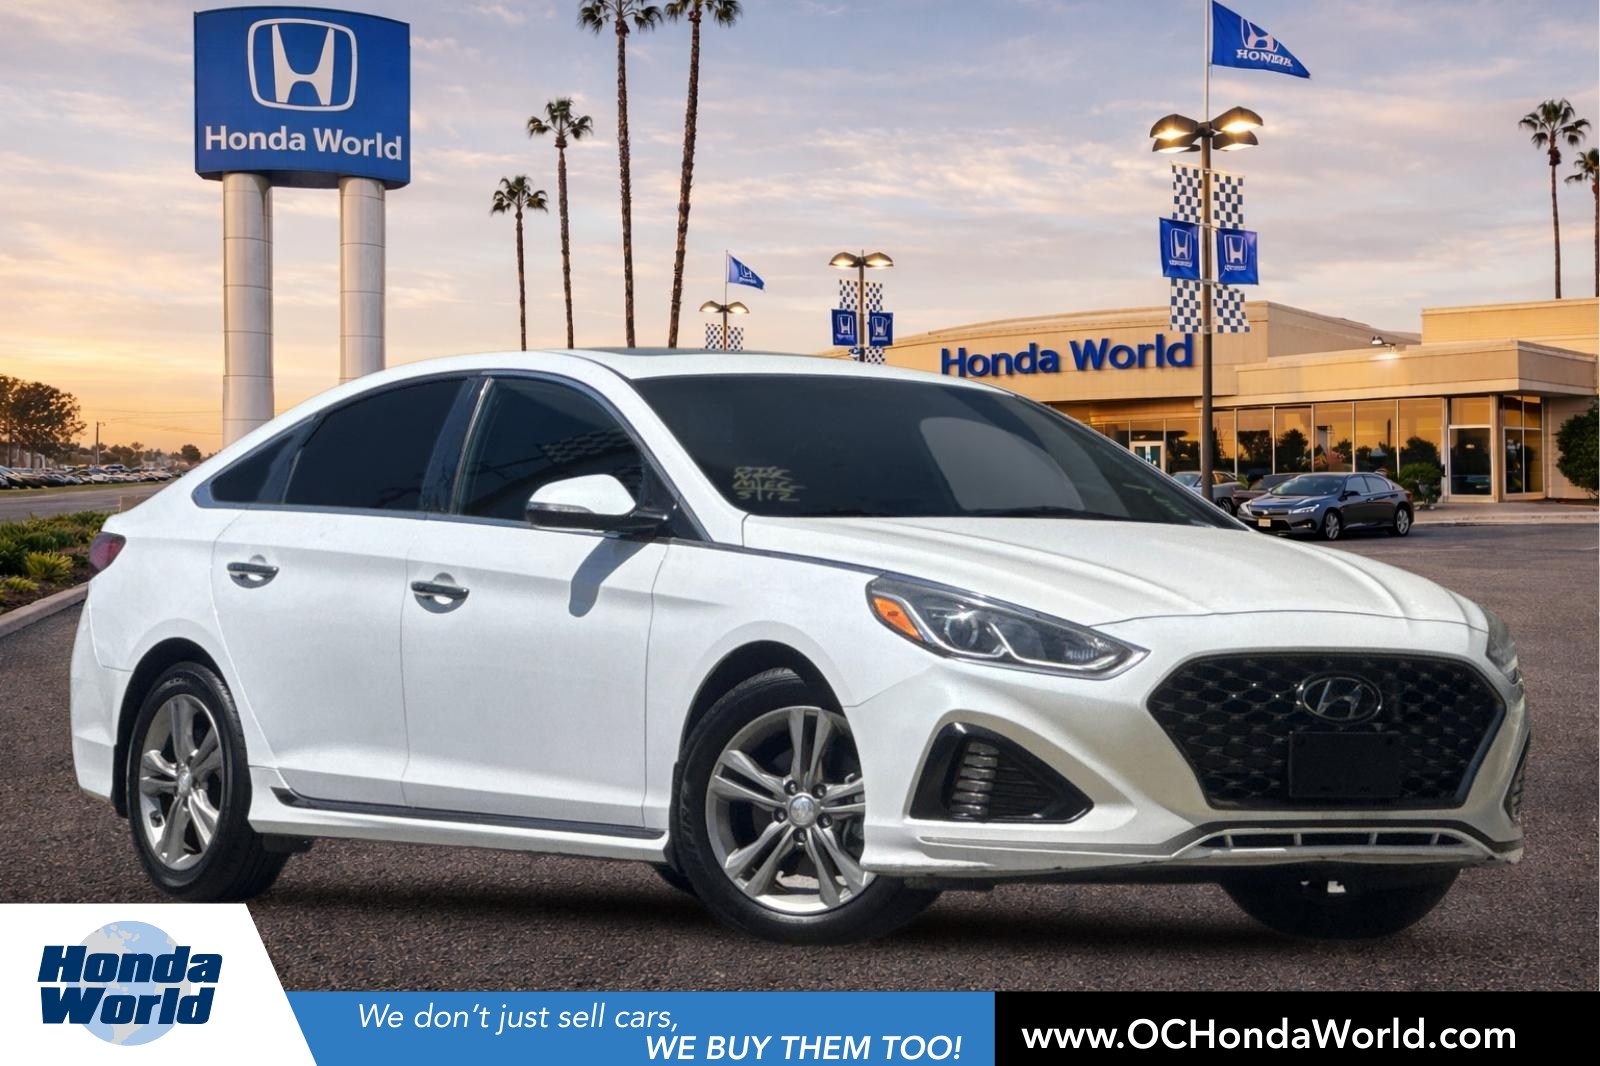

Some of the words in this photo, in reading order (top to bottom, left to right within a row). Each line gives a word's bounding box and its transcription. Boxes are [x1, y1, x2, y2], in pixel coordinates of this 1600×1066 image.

[205, 125, 306, 151] Honda
[313, 127, 402, 161] World
[941, 342, 1060, 377] Honda
[1069, 333, 1194, 370] World
